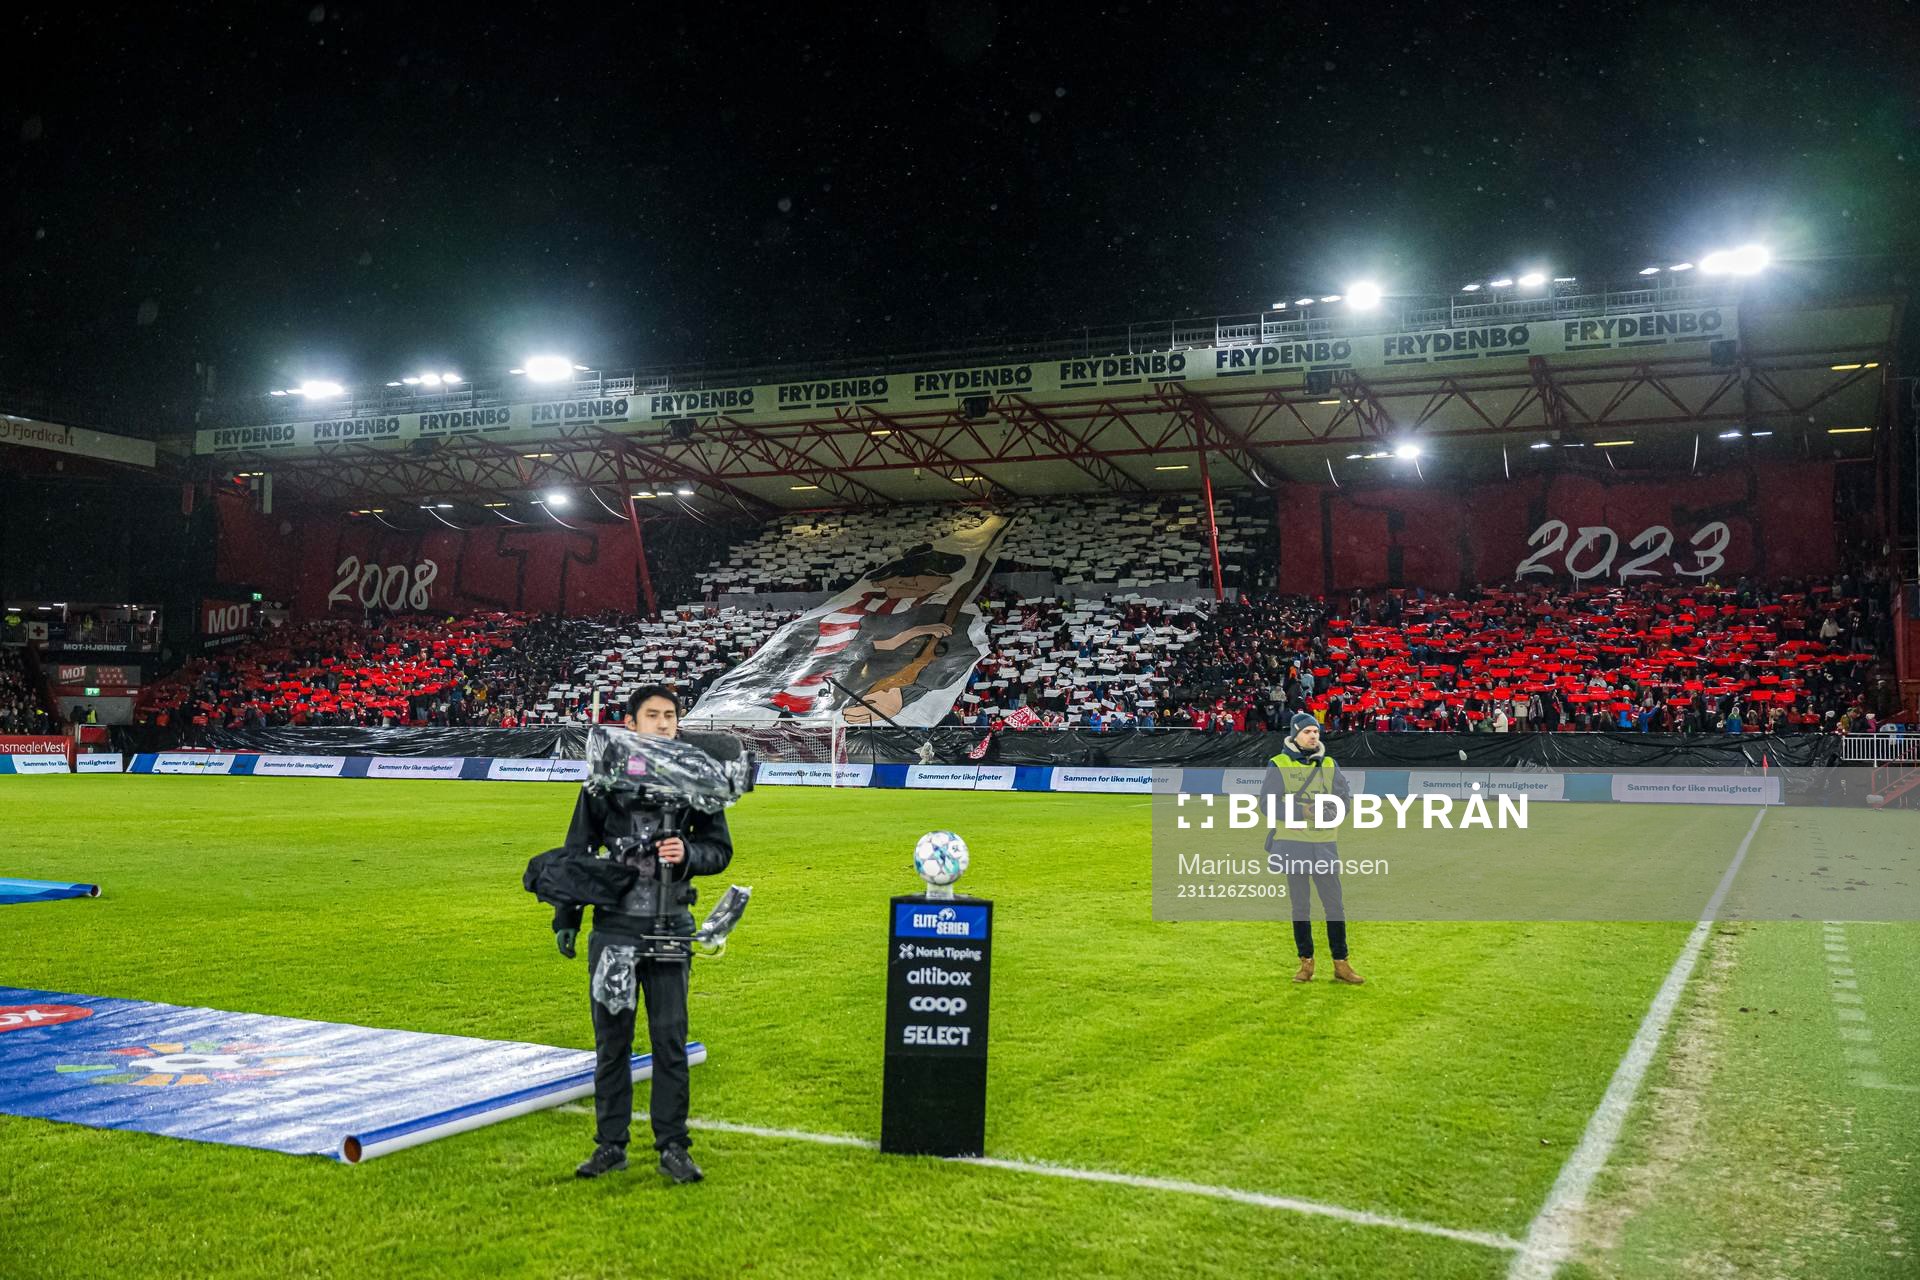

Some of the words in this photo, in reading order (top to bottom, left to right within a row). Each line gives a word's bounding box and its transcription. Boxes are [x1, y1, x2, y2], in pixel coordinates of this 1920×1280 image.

[1564, 309, 1723, 341] FRYDENBØ
[1384, 324, 1530, 356] FRYDENBØ
[1216, 340, 1352, 369] FRYDENBØ
[1060, 352, 1186, 380] FRYDENBØ
[778, 376, 888, 401] FRYDENBØ
[914, 365, 1032, 392] FRYDENBØ
[531, 397, 628, 420] FRYDENBØ
[651, 388, 755, 412] FRYDENBØ
[314, 416, 400, 437] FRYDENBØ
[420, 406, 511, 429] FRYDENBØ
[214, 424, 295, 446] FRYDENBØ
[1515, 520, 1730, 590] 2023
[328, 555, 438, 611] 2008
[822, 771, 860, 779] muigheter
[1064, 775, 1097, 783] Sammen
[1098, 775, 1110, 783] for
[1111, 775, 1125, 783] like
[1126, 776, 1169, 785] muligheter
[1480, 781, 1496, 789] like
[1498, 782, 1548, 790] muligheter
[1688, 784, 1706, 792] like
[1708, 785, 1762, 794] muligheter
[913, 913, 938, 928] ELITE
[937, 922, 969, 936] SERIEN
[916, 946, 945, 958] Norsk
[945, 947, 982, 961] Tipping
[906, 967, 972, 986] altibox
[909, 996, 968, 1016] coop
[903, 1025, 971, 1045] SELECT
